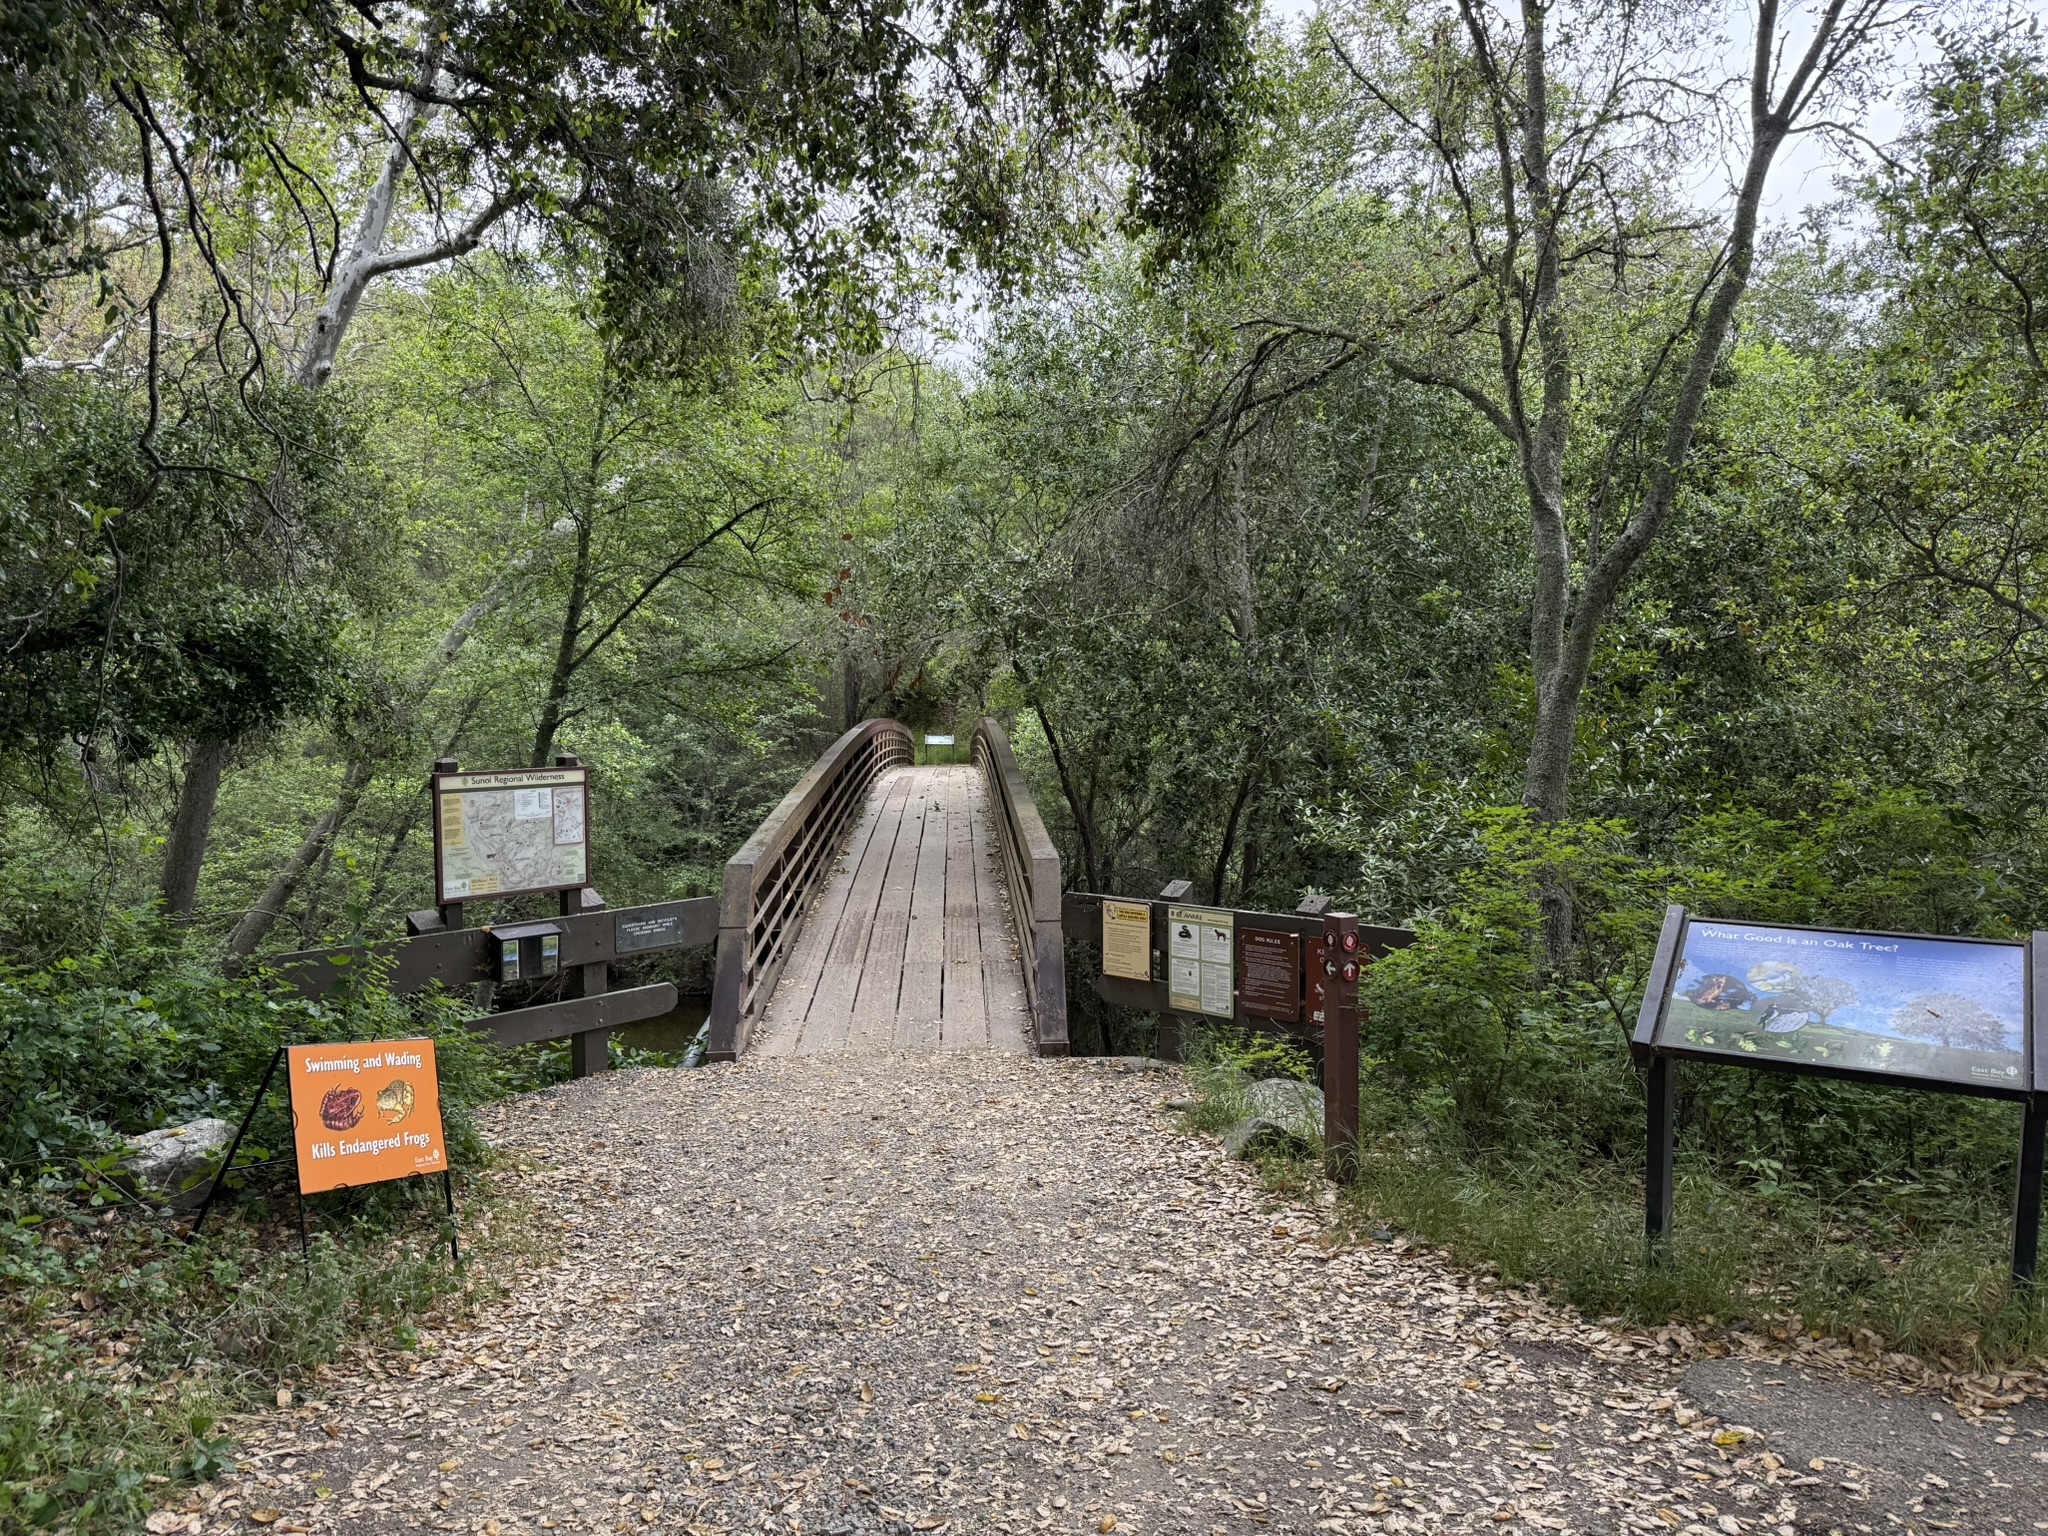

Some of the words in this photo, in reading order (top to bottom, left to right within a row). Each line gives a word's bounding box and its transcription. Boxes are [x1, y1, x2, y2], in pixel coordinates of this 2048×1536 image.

[471, 776, 492, 785] Sunol
[494, 775, 524, 785] Regional
[526, 773, 565, 782] Wilderness
[1184, 912, 1202, 920] AWARE
[1701, 929, 1739, 940] What
[1743, 933, 1782, 944] Good
[1786, 936, 1797, 944] is
[1801, 938, 1818, 946] an
[1823, 939, 1854, 949] Oak
[1859, 941, 1899, 953] Tree?
[305, 1055, 360, 1073] Swimming
[363, 1053, 382, 1068] and
[385, 1051, 422, 1069] Wading
[1990, 1068, 2005, 1076] Bay
[312, 1142, 336, 1159] Kills
[339, 1133, 401, 1155] Endangered
[404, 1131, 430, 1148] Frogs
